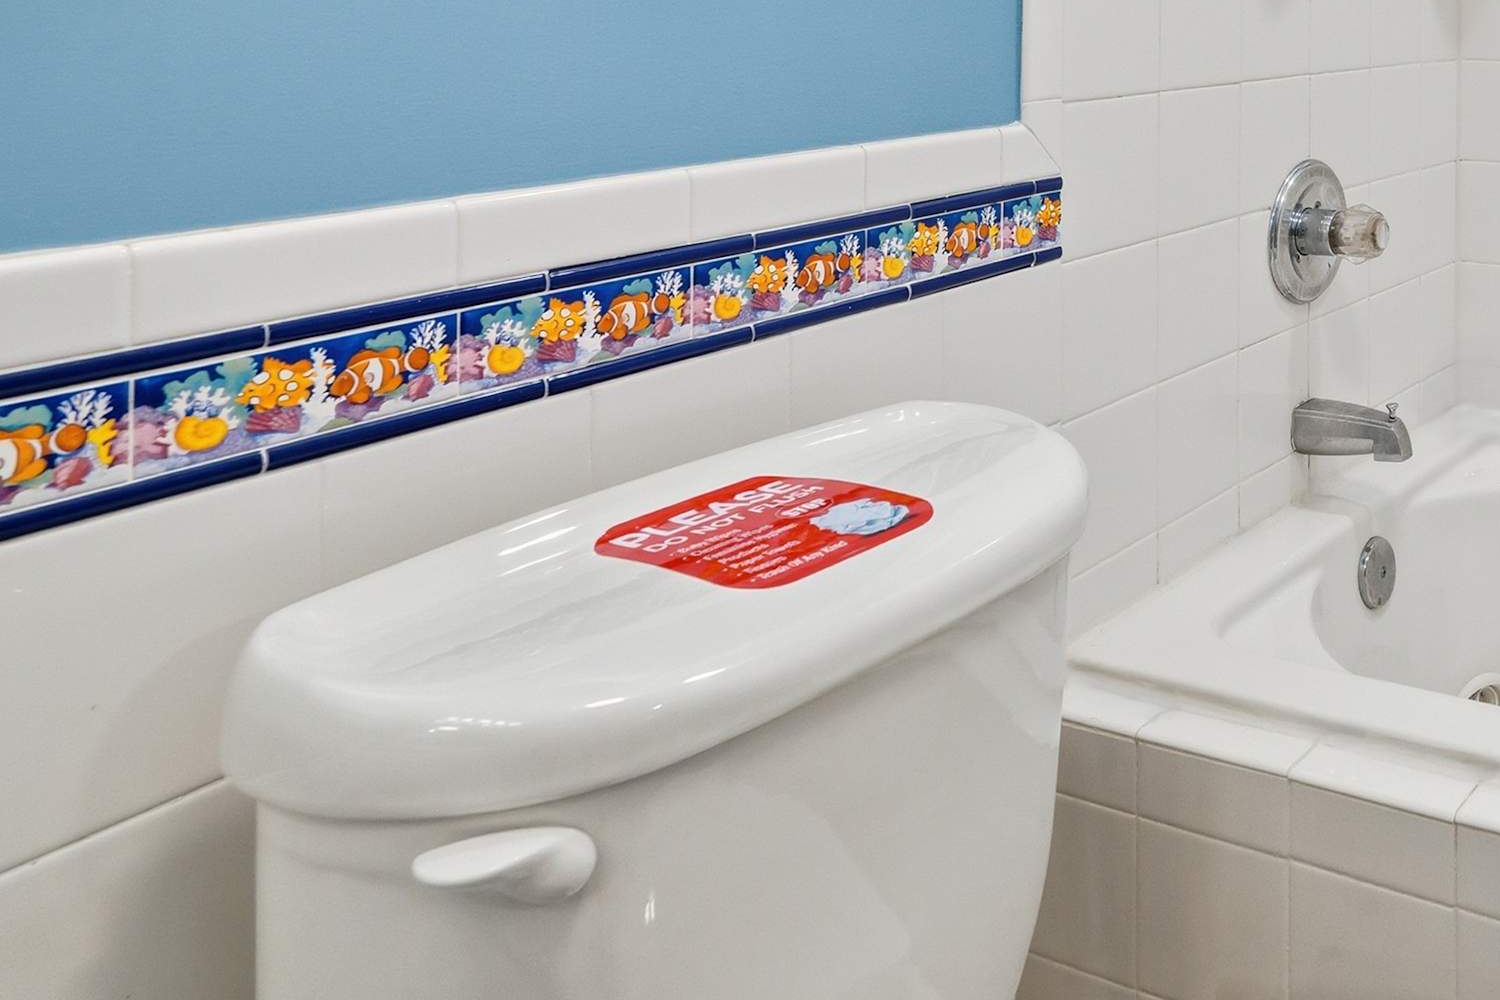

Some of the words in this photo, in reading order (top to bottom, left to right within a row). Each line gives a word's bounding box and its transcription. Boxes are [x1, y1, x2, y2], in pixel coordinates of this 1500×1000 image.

[608, 480, 804, 548] PLEASE
[642, 535, 688, 552] DO
[690, 511, 746, 535] NOT
[748, 486, 824, 513] FLUSH
